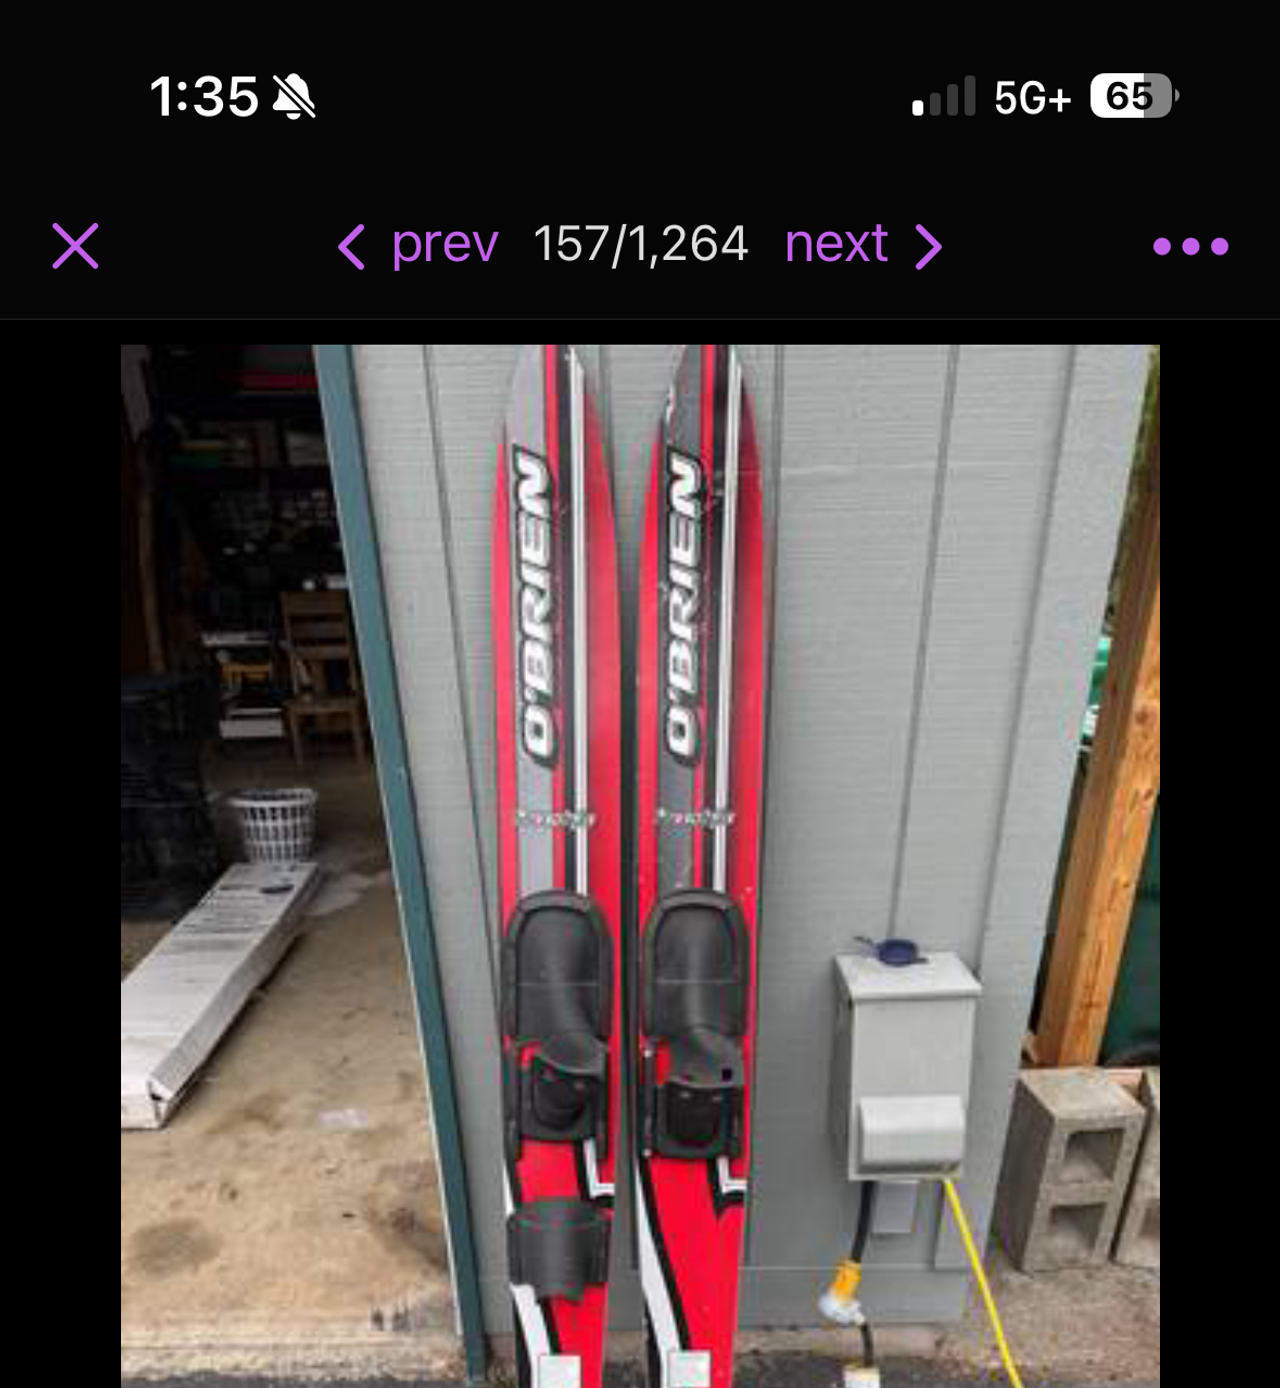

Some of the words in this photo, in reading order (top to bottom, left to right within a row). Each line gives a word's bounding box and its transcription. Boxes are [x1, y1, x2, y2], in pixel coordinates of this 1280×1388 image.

[150, 75, 259, 118] 1:35
[995, 79, 1072, 116] 5G+
[1106, 81, 1154, 111] 65
[393, 230, 499, 272] prev
[534, 223, 749, 270] 157/1,264
[786, 223, 889, 263] next
[514, 451, 556, 765] O'BRIEN
[664, 451, 704, 764] O'BRIEN
